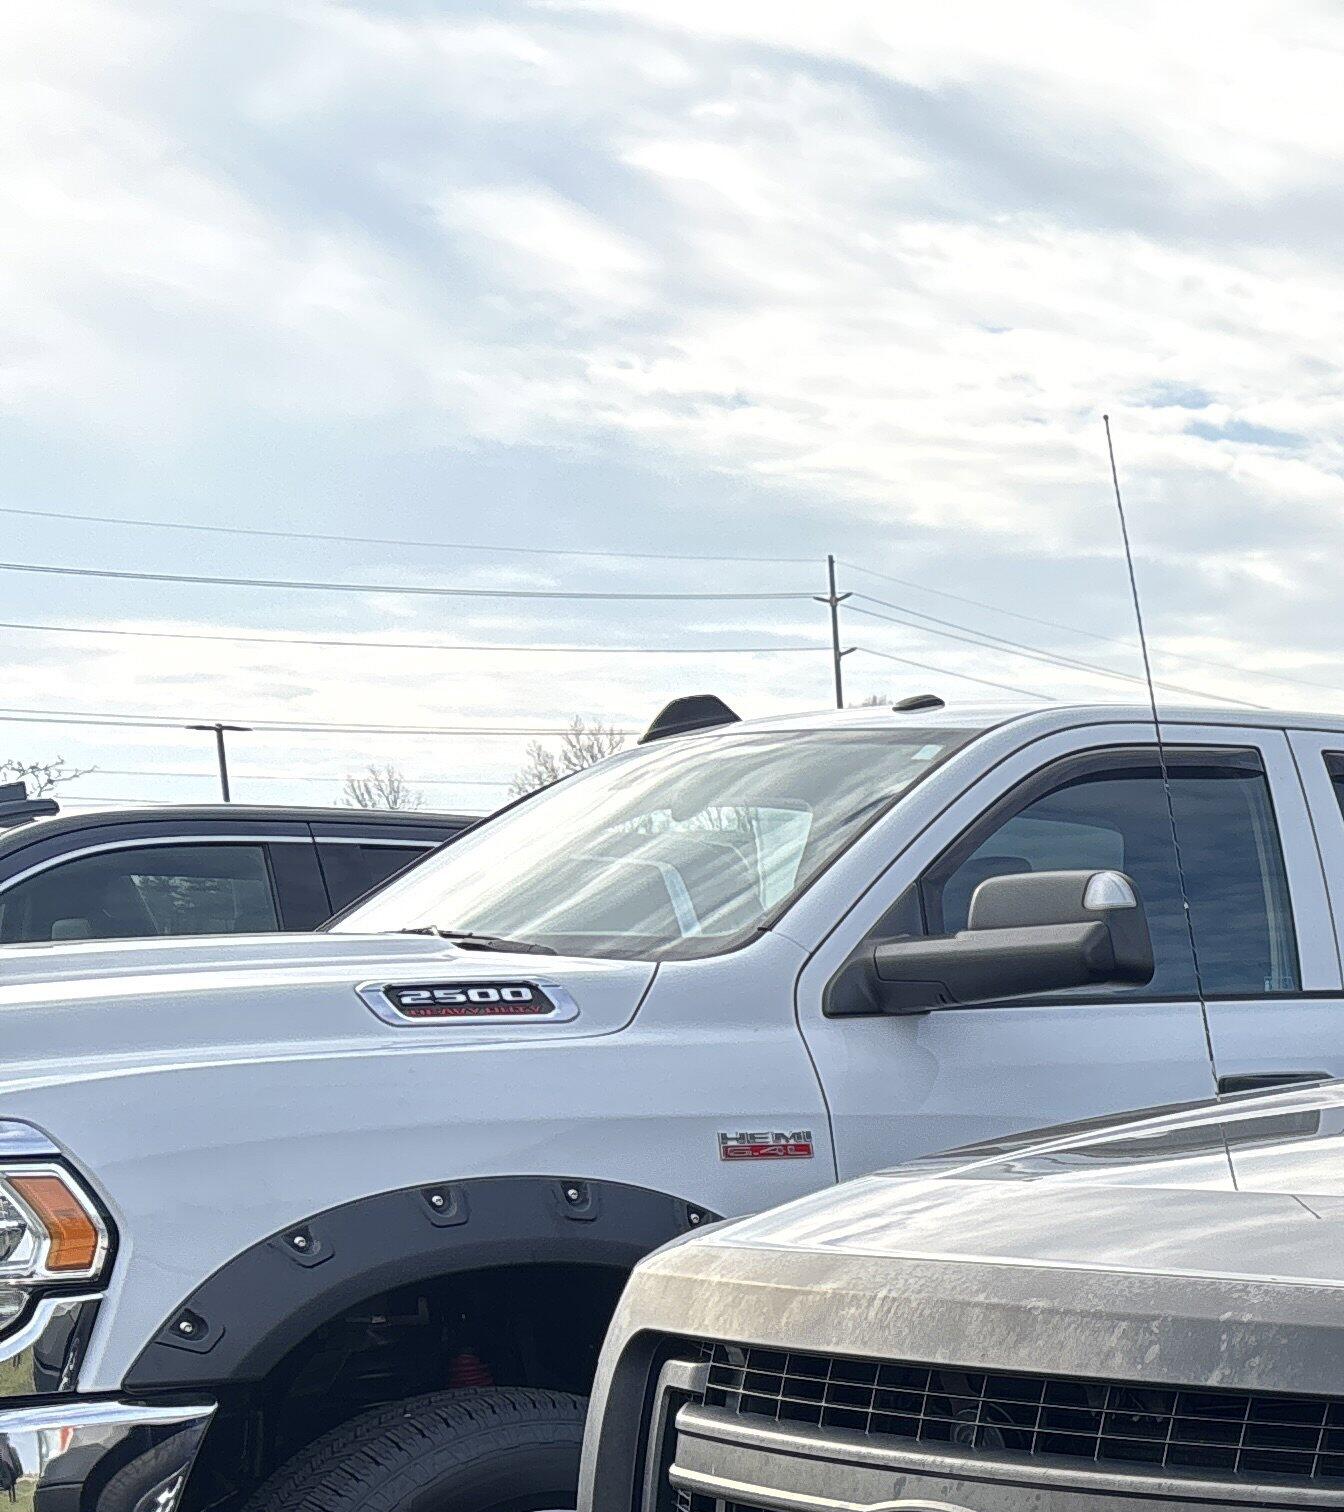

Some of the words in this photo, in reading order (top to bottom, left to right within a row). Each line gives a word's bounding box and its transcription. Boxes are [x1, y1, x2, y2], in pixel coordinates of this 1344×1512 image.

[399, 987, 533, 1004] 2500
[719, 1131, 812, 1144] HEMI
[727, 1146, 809, 1157] 6.4L
